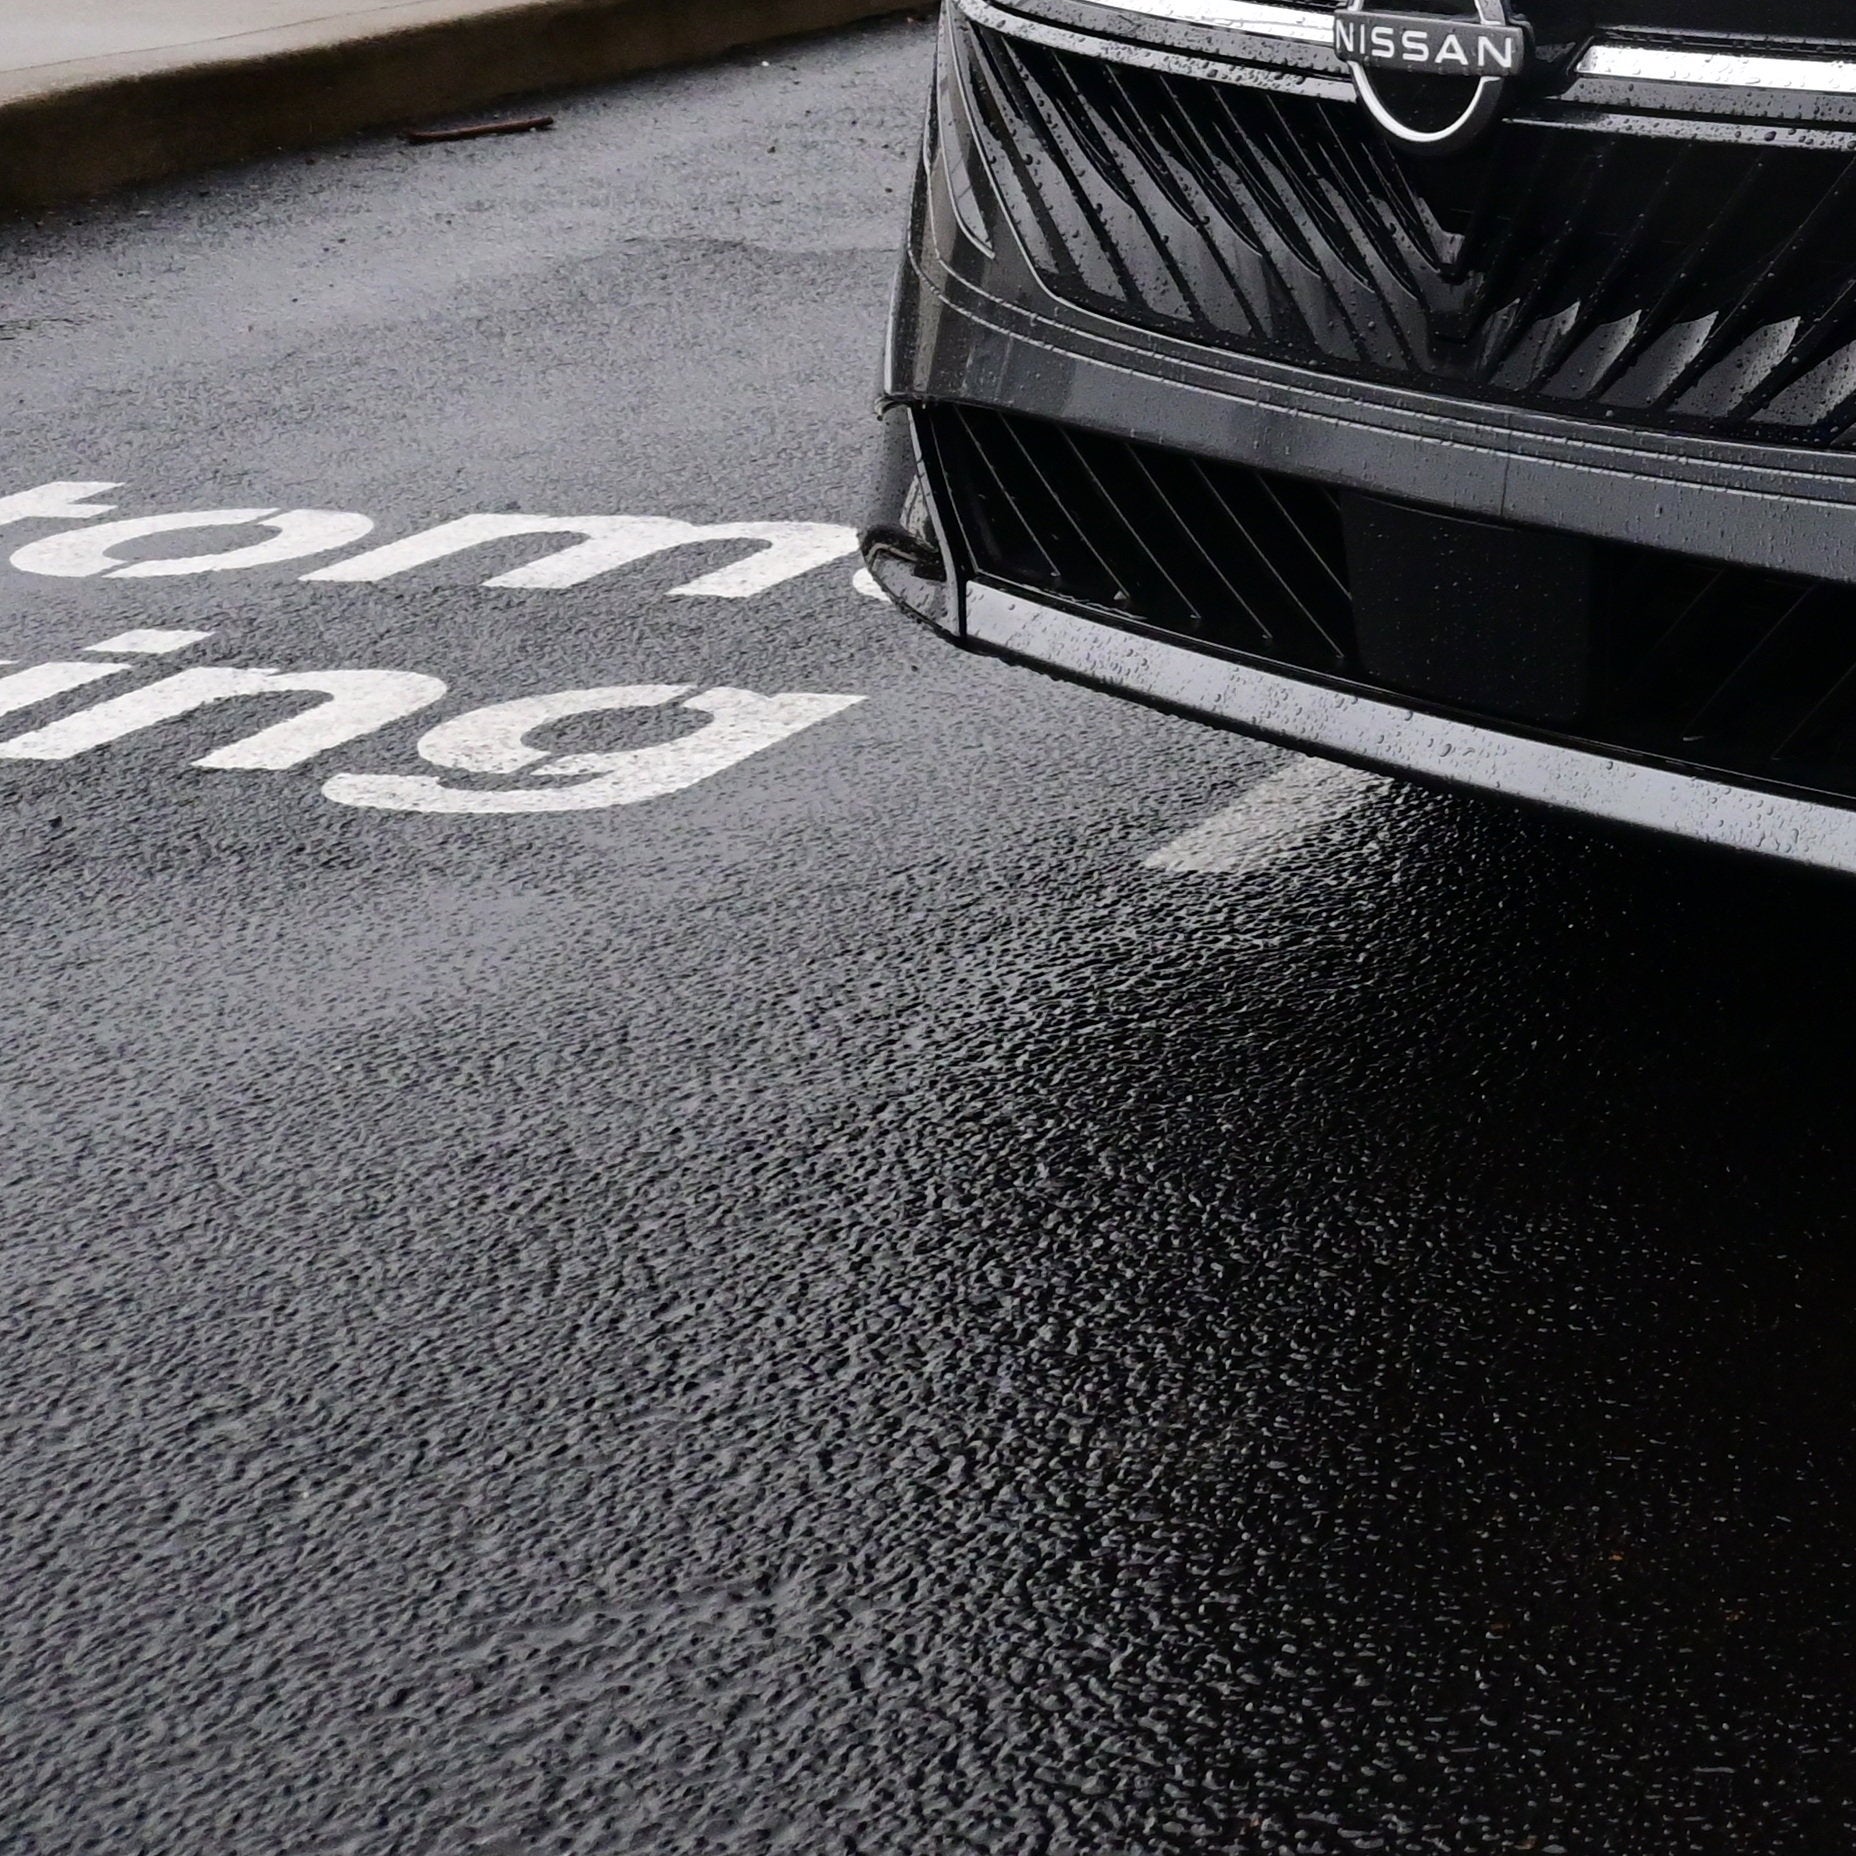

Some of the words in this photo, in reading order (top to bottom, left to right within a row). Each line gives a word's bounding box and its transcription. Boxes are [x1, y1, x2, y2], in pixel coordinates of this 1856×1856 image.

[1335, 19, 1512, 68] NISSAN
[0, 480, 896, 603] tom
[0, 628, 868, 813] ing
